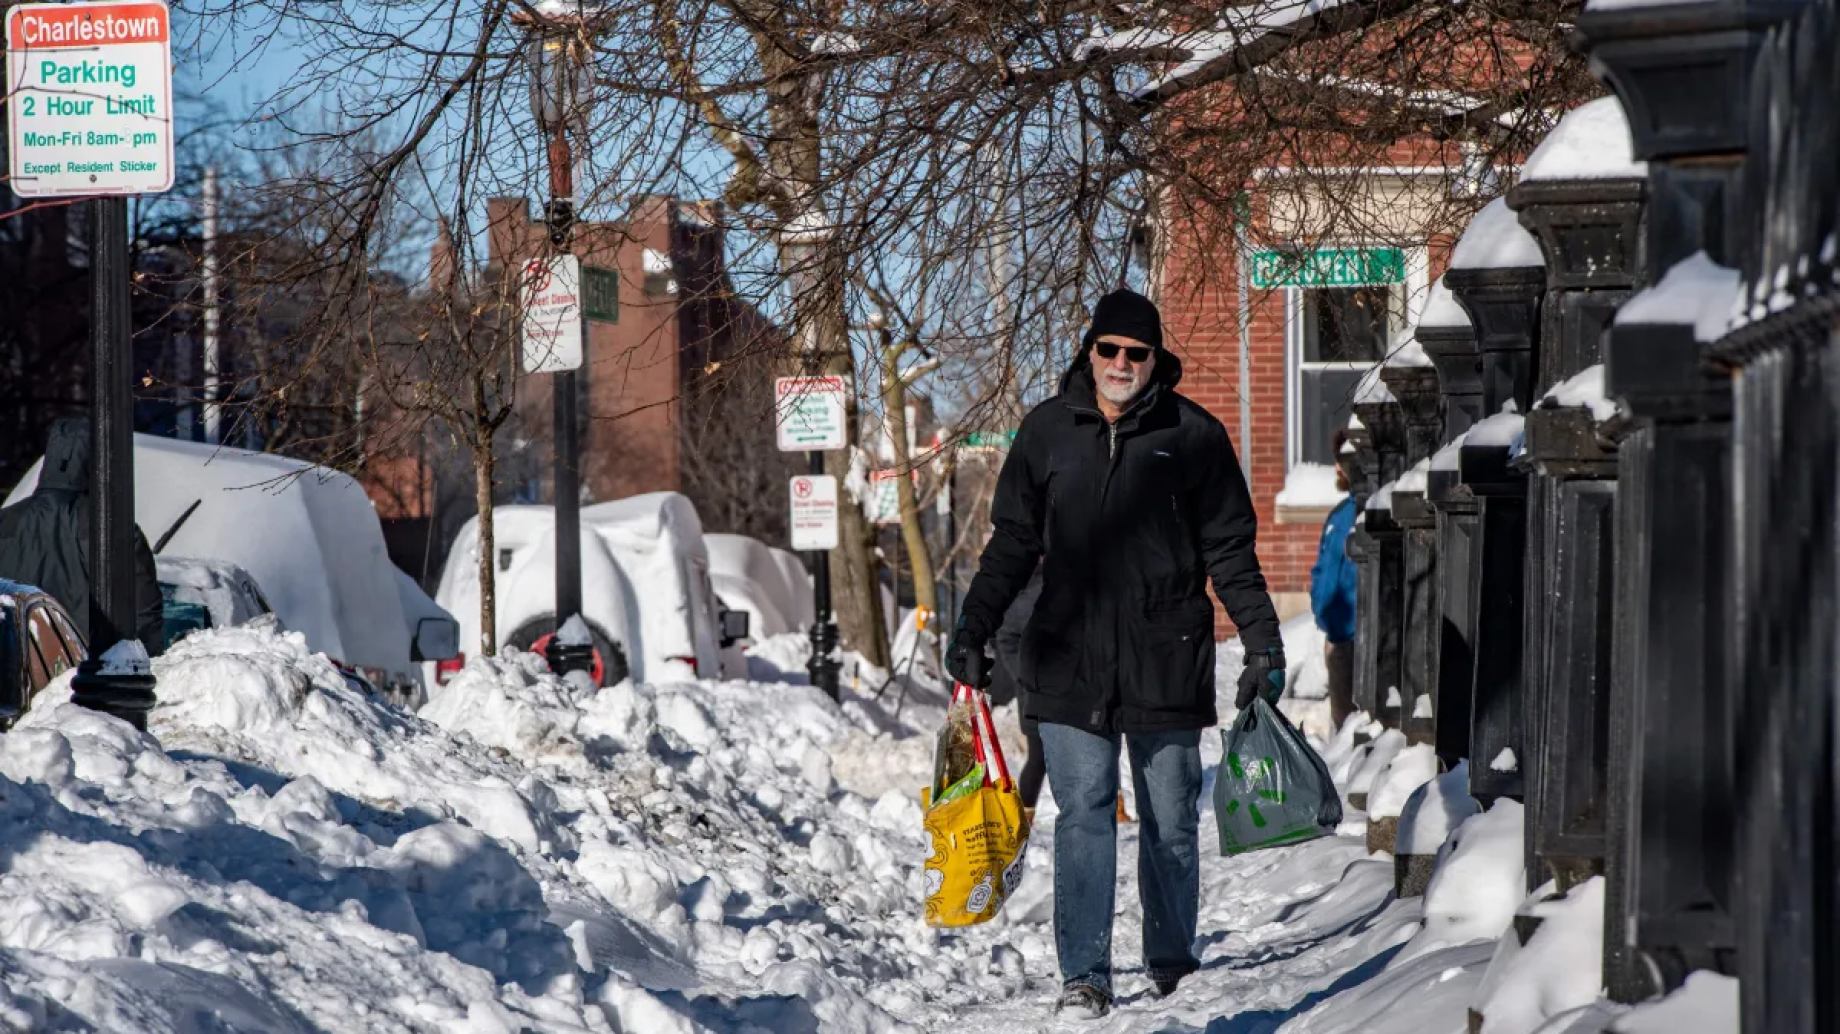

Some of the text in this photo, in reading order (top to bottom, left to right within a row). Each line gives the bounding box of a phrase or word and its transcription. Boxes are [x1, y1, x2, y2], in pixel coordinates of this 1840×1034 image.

[22, 15, 159, 43] Charlestown
[40, 60, 136, 87] Parking
[23, 95, 156, 116] 2 Hour Limit
[24, 131, 157, 148] Mon-Fri 8am-pm
[24, 160, 157, 175] Except Resident Sticker
